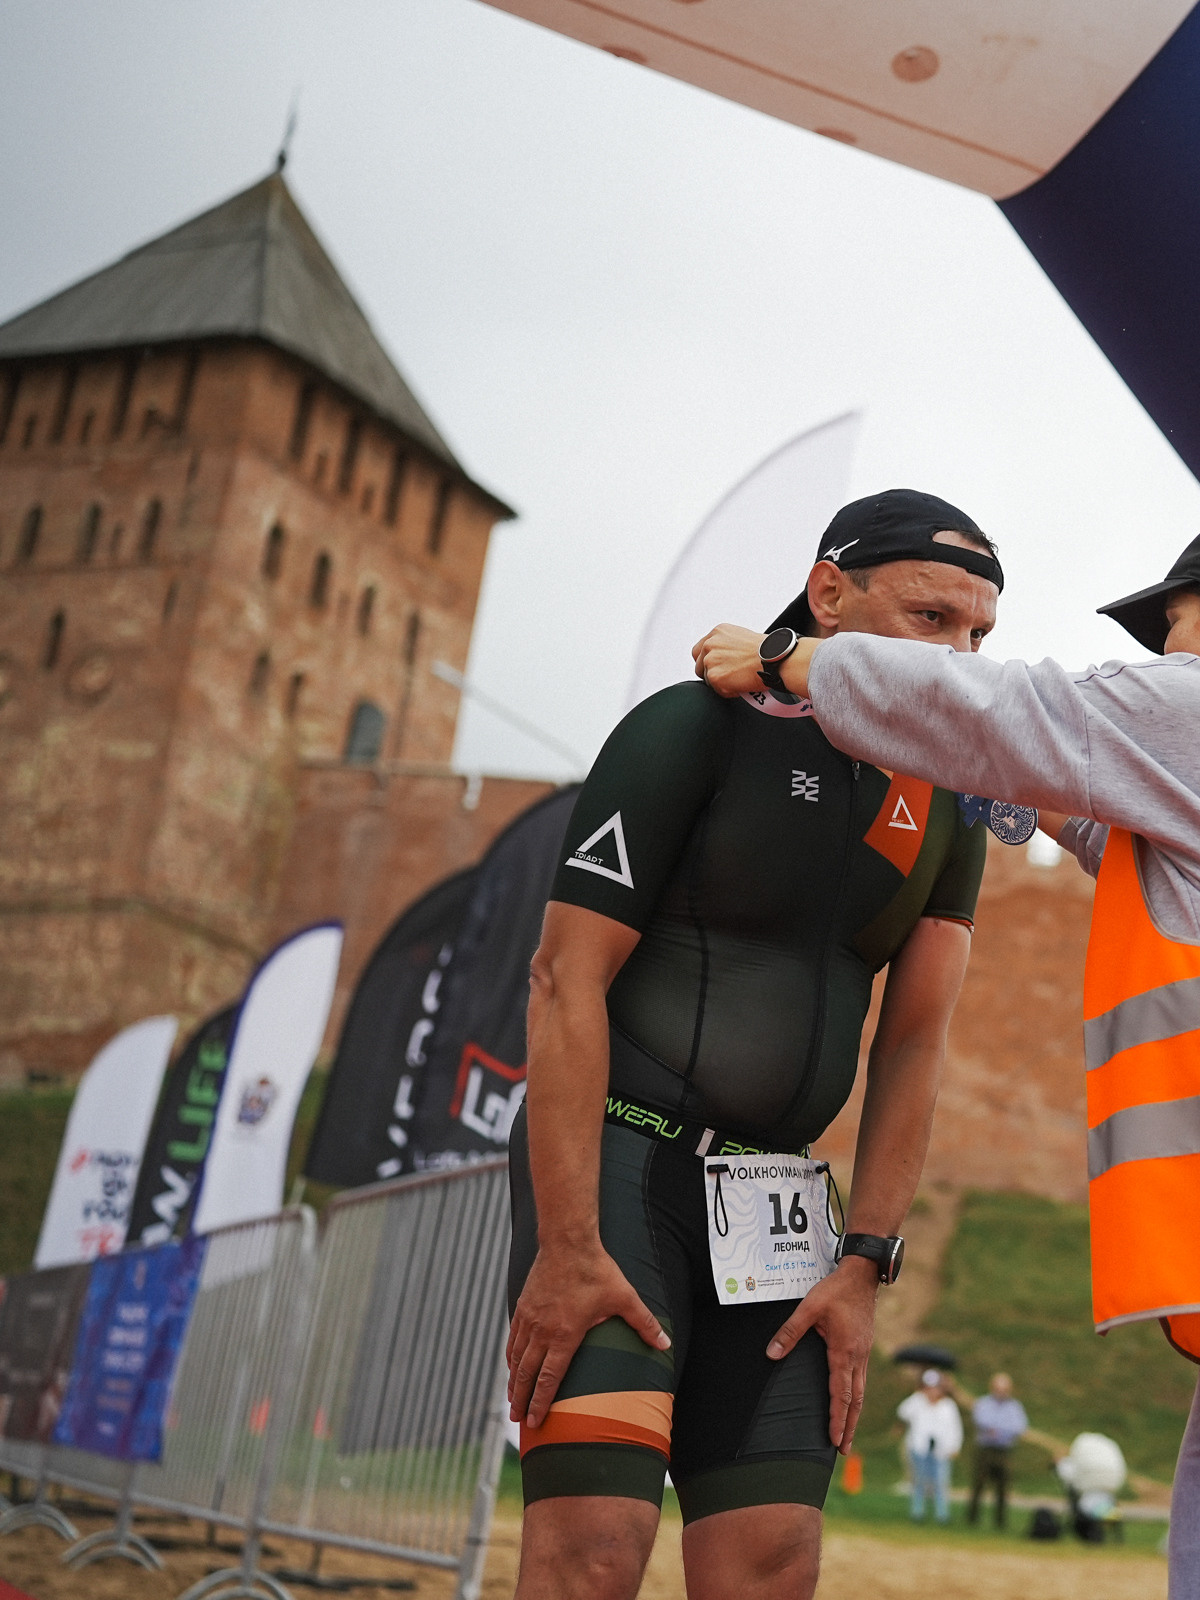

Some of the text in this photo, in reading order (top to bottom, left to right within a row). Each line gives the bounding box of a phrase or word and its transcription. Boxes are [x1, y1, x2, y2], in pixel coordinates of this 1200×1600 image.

[166, 1039, 227, 1163] LIFE
[606, 1097, 683, 1139] WERU
[768, 1192, 809, 1236] 16
[773, 1240, 810, 1253] ЛЕОНИД
